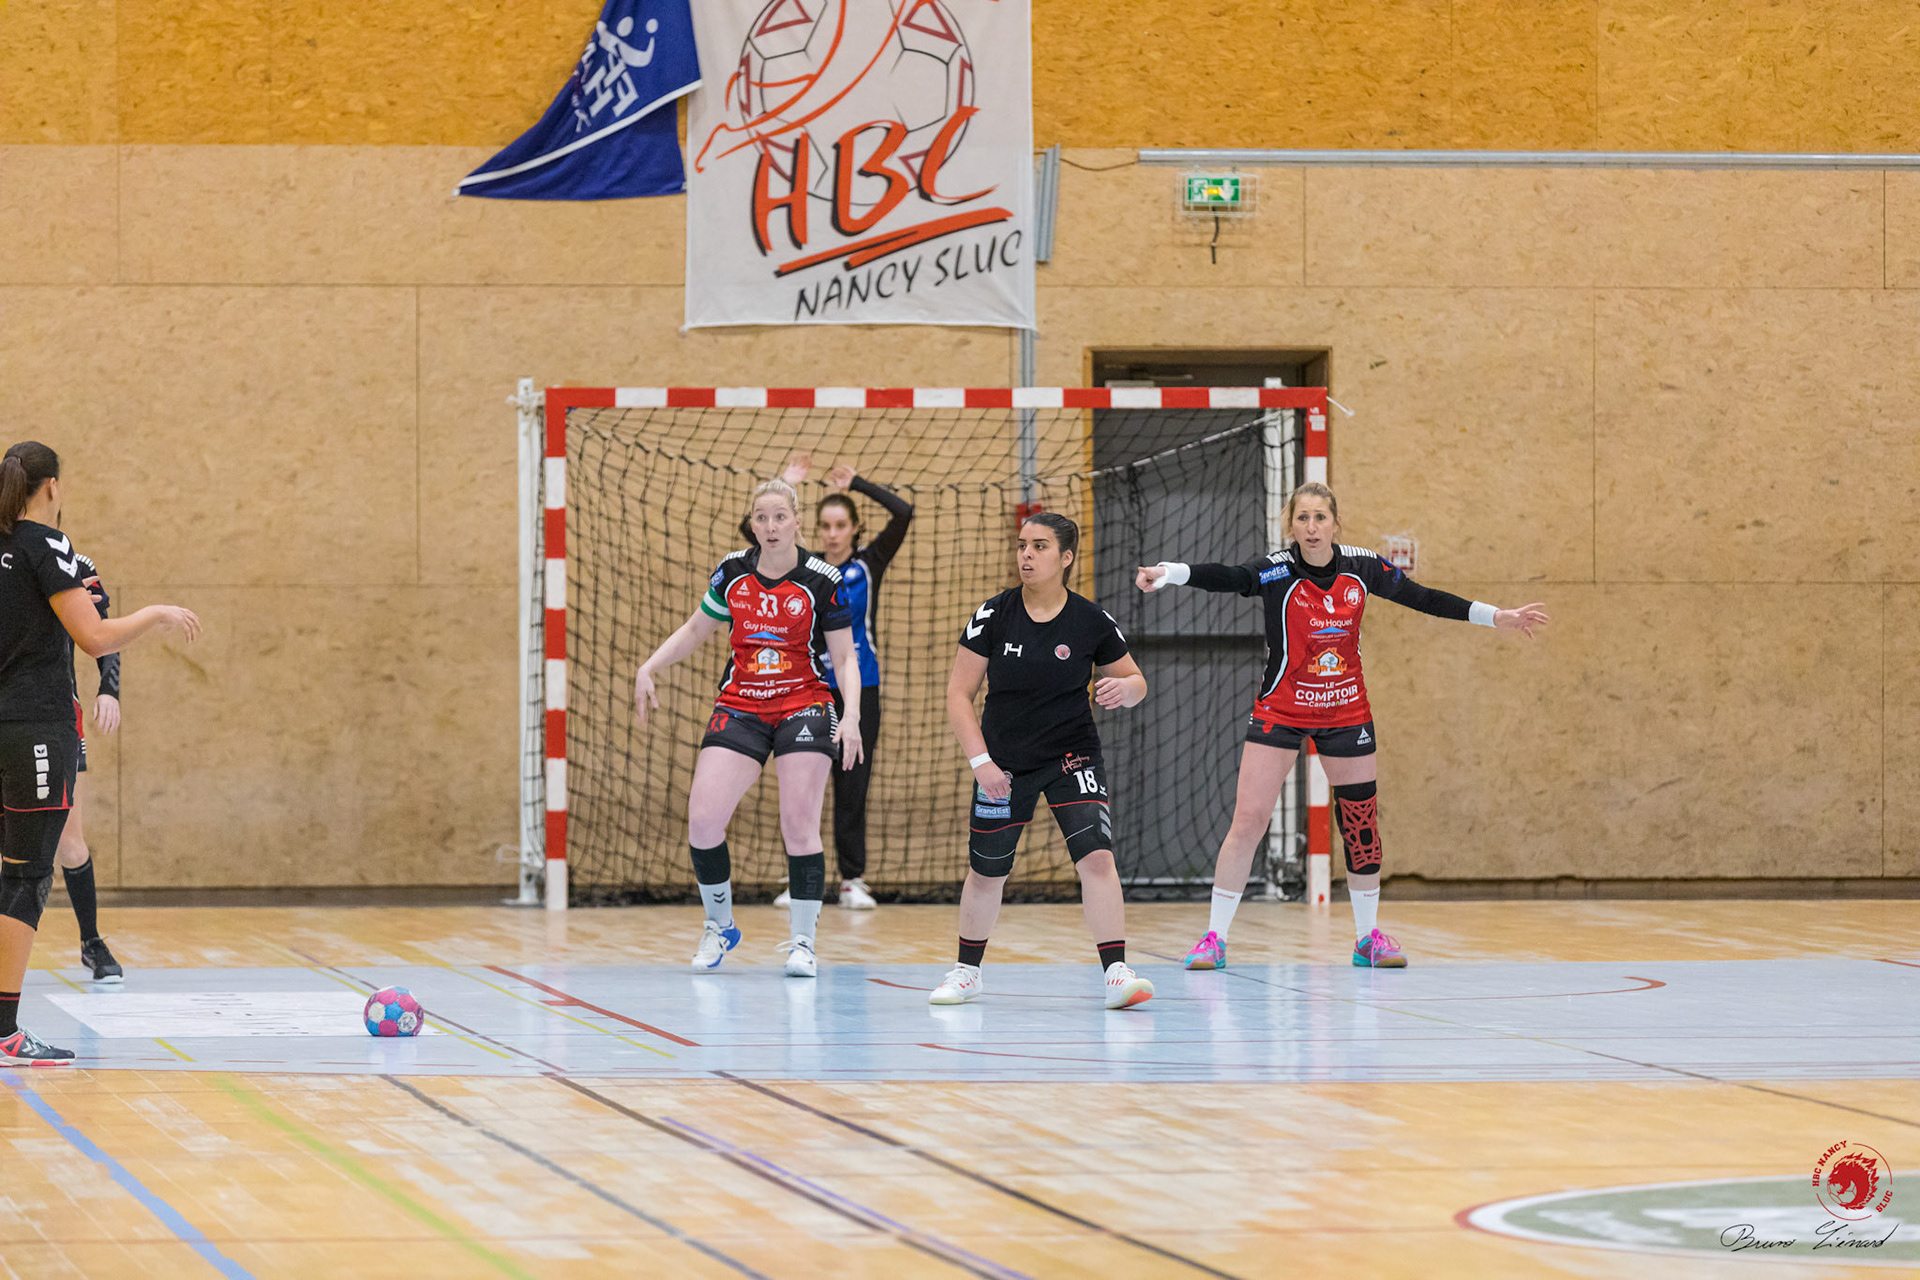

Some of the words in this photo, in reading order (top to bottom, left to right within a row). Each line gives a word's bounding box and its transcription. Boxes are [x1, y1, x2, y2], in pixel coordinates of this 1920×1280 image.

[751, 106, 998, 257] HBC
[794, 255, 922, 321] NANCY
[934, 229, 1022, 287] SLUC
[743, 620, 759, 632] Guy
[760, 622, 788, 634] Hoquet
[1309, 618, 1325, 628] Guy
[1325, 618, 1352, 628] Hoquet
[1295, 685, 1358, 702] COMPTOIR
[1356, 737, 1372, 746] SELECT
[1073, 770, 1098, 794] 18
[976, 806, 997, 814] Grand
